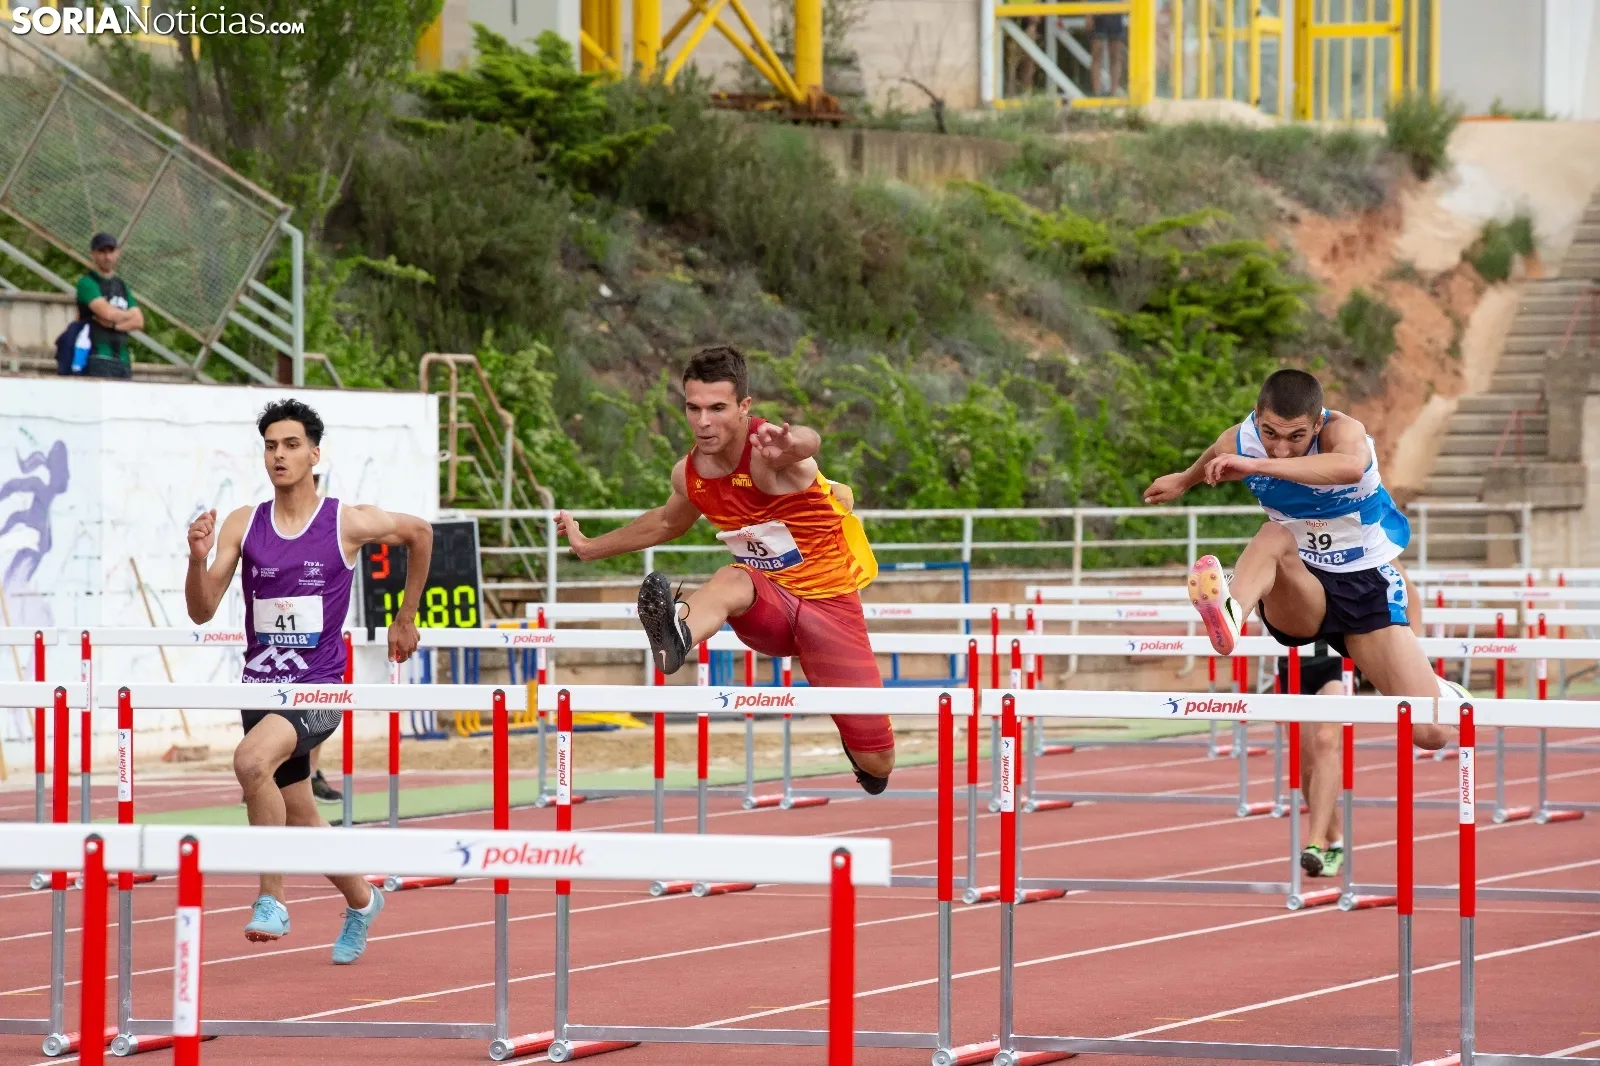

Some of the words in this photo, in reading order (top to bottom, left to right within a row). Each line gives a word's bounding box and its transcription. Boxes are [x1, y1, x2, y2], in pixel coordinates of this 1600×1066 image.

[747, 541, 768, 557] 45
[1306, 531, 1332, 551] 39
[275, 615, 296, 631] 41
[203, 632, 244, 643] polanik
[513, 634, 556, 645] polanik
[1140, 641, 1184, 653] polanik
[1473, 643, 1518, 655] polanik
[293, 690, 354, 706] polanik
[734, 692, 796, 709] polanik
[1184, 698, 1248, 715] polanik
[118, 746, 128, 783] polanik
[559, 749, 567, 787] polanik
[1001, 756, 1011, 793] polanik
[1461, 766, 1472, 805] polanik
[482, 842, 585, 870] polanik
